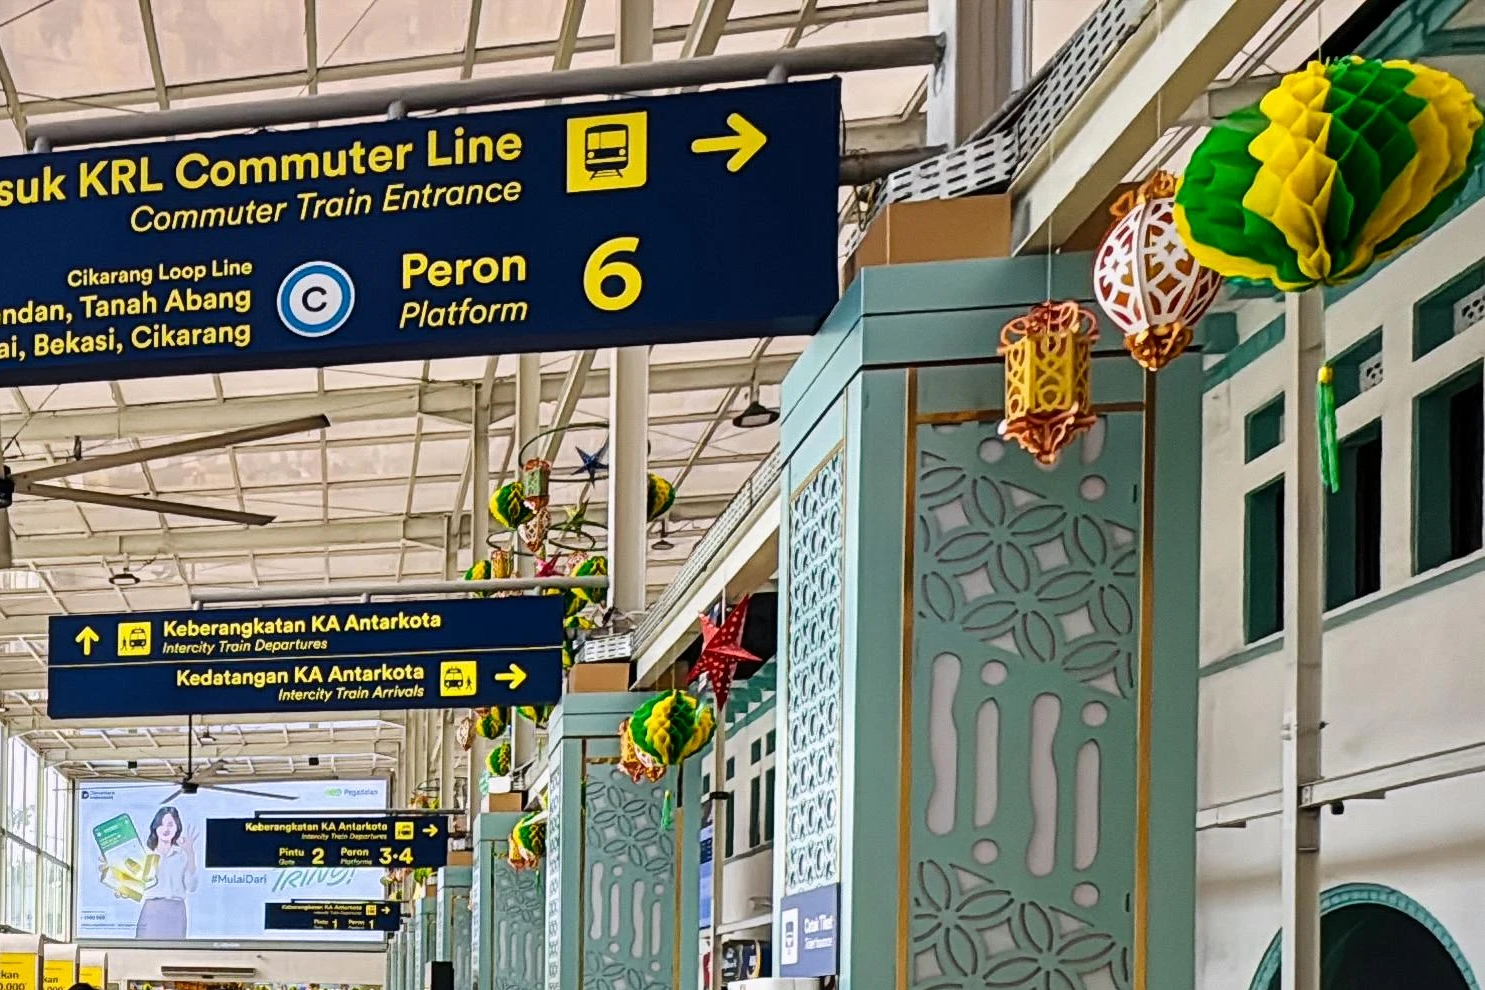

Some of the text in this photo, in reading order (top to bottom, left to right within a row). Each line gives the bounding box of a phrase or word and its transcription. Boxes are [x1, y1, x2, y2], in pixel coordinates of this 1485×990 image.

[79, 156, 164, 198] KRL
[175, 141, 413, 189] Commuter
[427, 127, 523, 167] Line
[131, 181, 522, 232] Commuter Train Entrance
[67, 259, 253, 287] Cikarang Loop Line
[402, 252, 526, 290] Peron
[583, 236, 643, 311] 6
[80, 290, 157, 319] Tanah
[165, 288, 252, 312] Abang
[301, 286, 328, 313] C
[399, 298, 528, 329] Platform
[34, 326, 123, 357] Bekasi,
[131, 323, 251, 349] Cikarang
[163, 611, 442, 639] Keberangkatan KA Antarkota
[162, 638, 328, 655] Intercity Train Departures
[176, 663, 425, 688] Kedatangan KA Antarkota
[278, 684, 425, 702] Intercity Train Arrivals
[245, 820, 388, 833] Keberangkatan KA Antarkota
[278, 847, 305, 857] Pintu
[311, 847, 325, 865] 2
[340, 847, 370, 857] Peron
[211, 873, 267, 885] #MulaiDari
